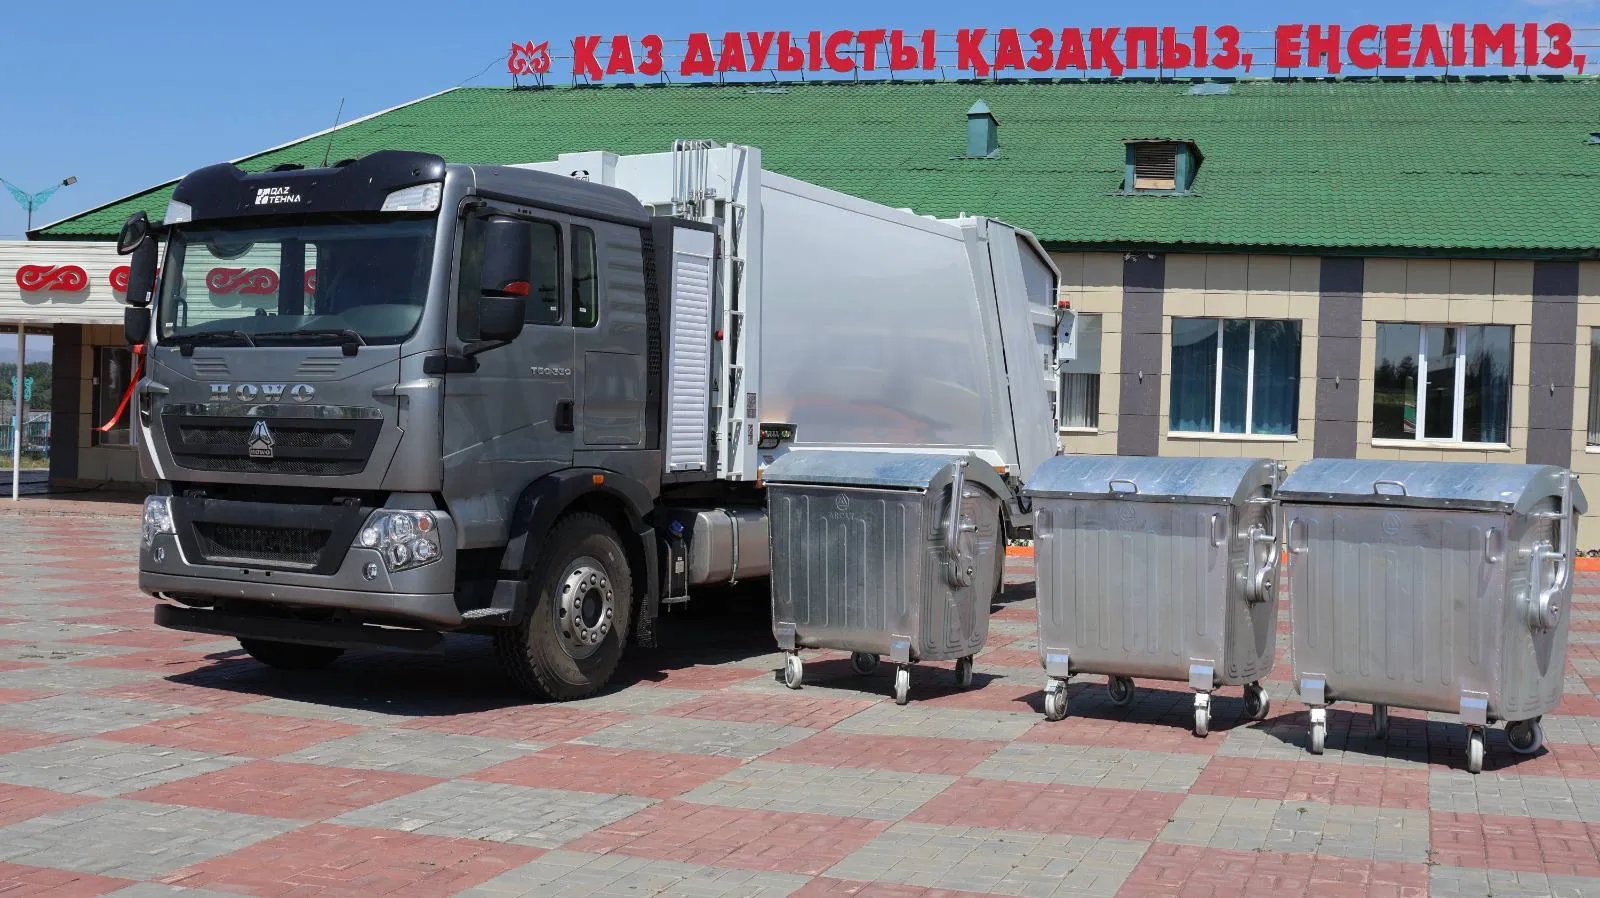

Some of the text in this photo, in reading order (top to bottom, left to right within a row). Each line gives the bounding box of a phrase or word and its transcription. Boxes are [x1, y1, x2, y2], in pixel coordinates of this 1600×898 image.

[574, 22, 1587, 80] ҚАЗ ДАУЫСТЫ ҚАЗАҚПЫЗ, ЕҢСЕЛІМІЗ,
[270, 186, 290, 195] QAZ
[269, 194, 301, 204] TEHNA
[209, 383, 316, 402] HOWO
